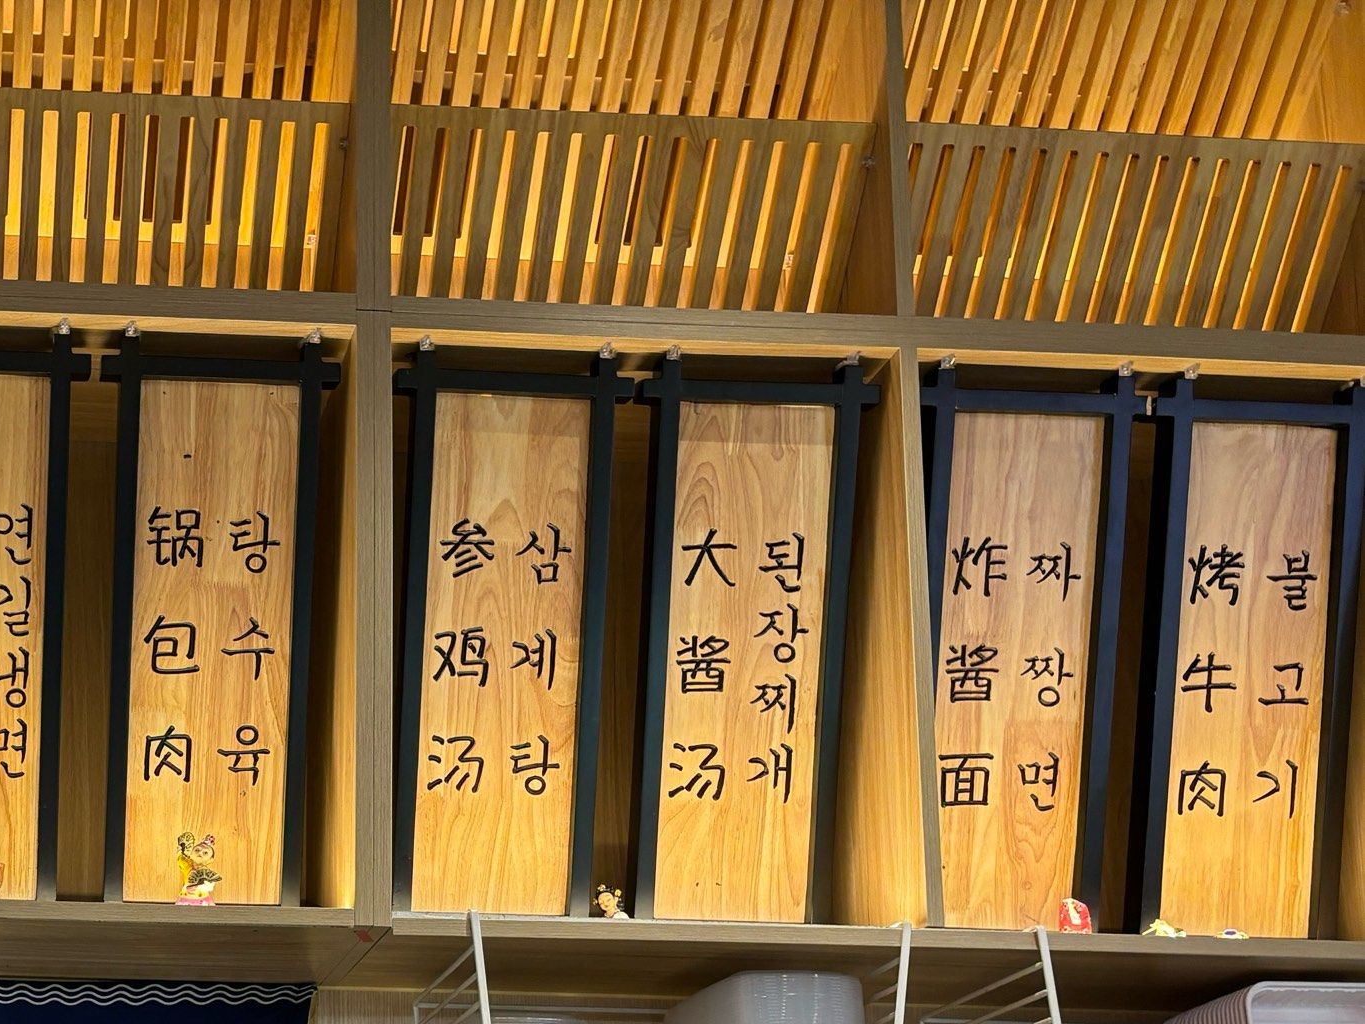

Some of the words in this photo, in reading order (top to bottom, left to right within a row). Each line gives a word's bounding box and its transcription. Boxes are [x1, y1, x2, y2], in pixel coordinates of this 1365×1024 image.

[144, 506, 204, 783] 锅包肉
[217, 511, 281, 786] 탕수육
[426, 518, 495, 793] 参鸡汤
[510, 522, 573, 796] 삼계탕
[668, 528, 738, 801] 大酱汤
[747, 532, 809, 803] 된장찌개
[938, 536, 1008, 808] 炸酱面
[1019, 542, 1081, 812] 짜짱면
[1177, 543, 1245, 818] 烤牛肉
[1252, 550, 1318, 820] 불고기
